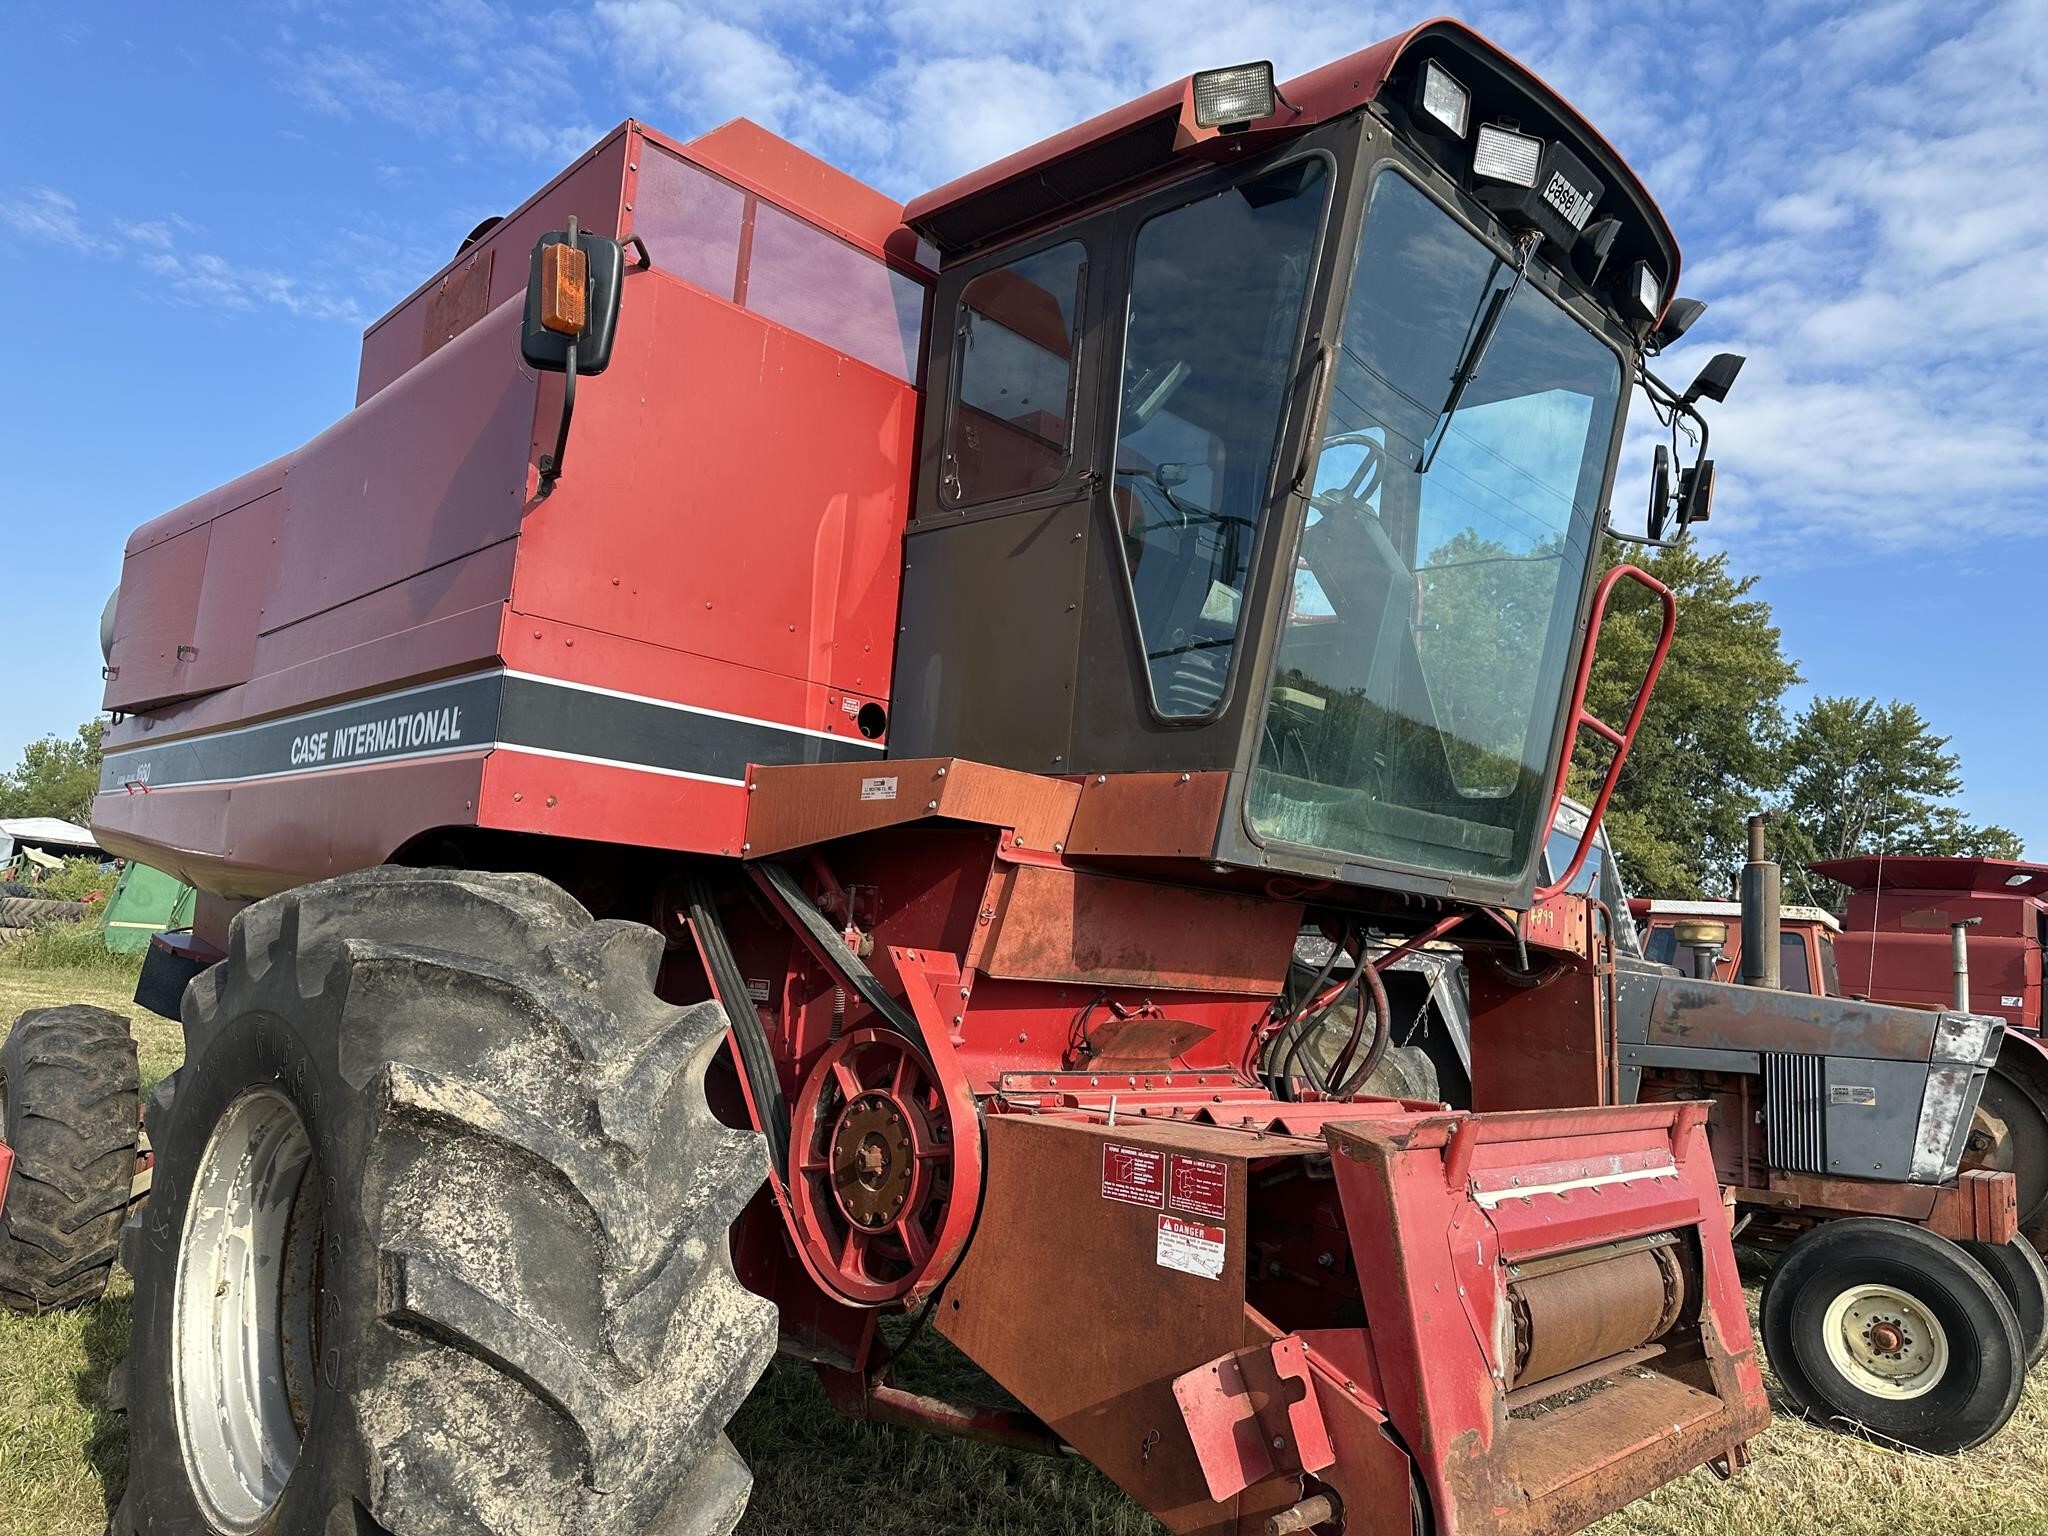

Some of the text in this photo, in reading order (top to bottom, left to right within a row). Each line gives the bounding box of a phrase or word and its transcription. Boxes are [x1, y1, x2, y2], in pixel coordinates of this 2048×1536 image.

[291, 706, 461, 765] CASE INTERNATIONAL
[1173, 1223, 1205, 1239] DANGER
